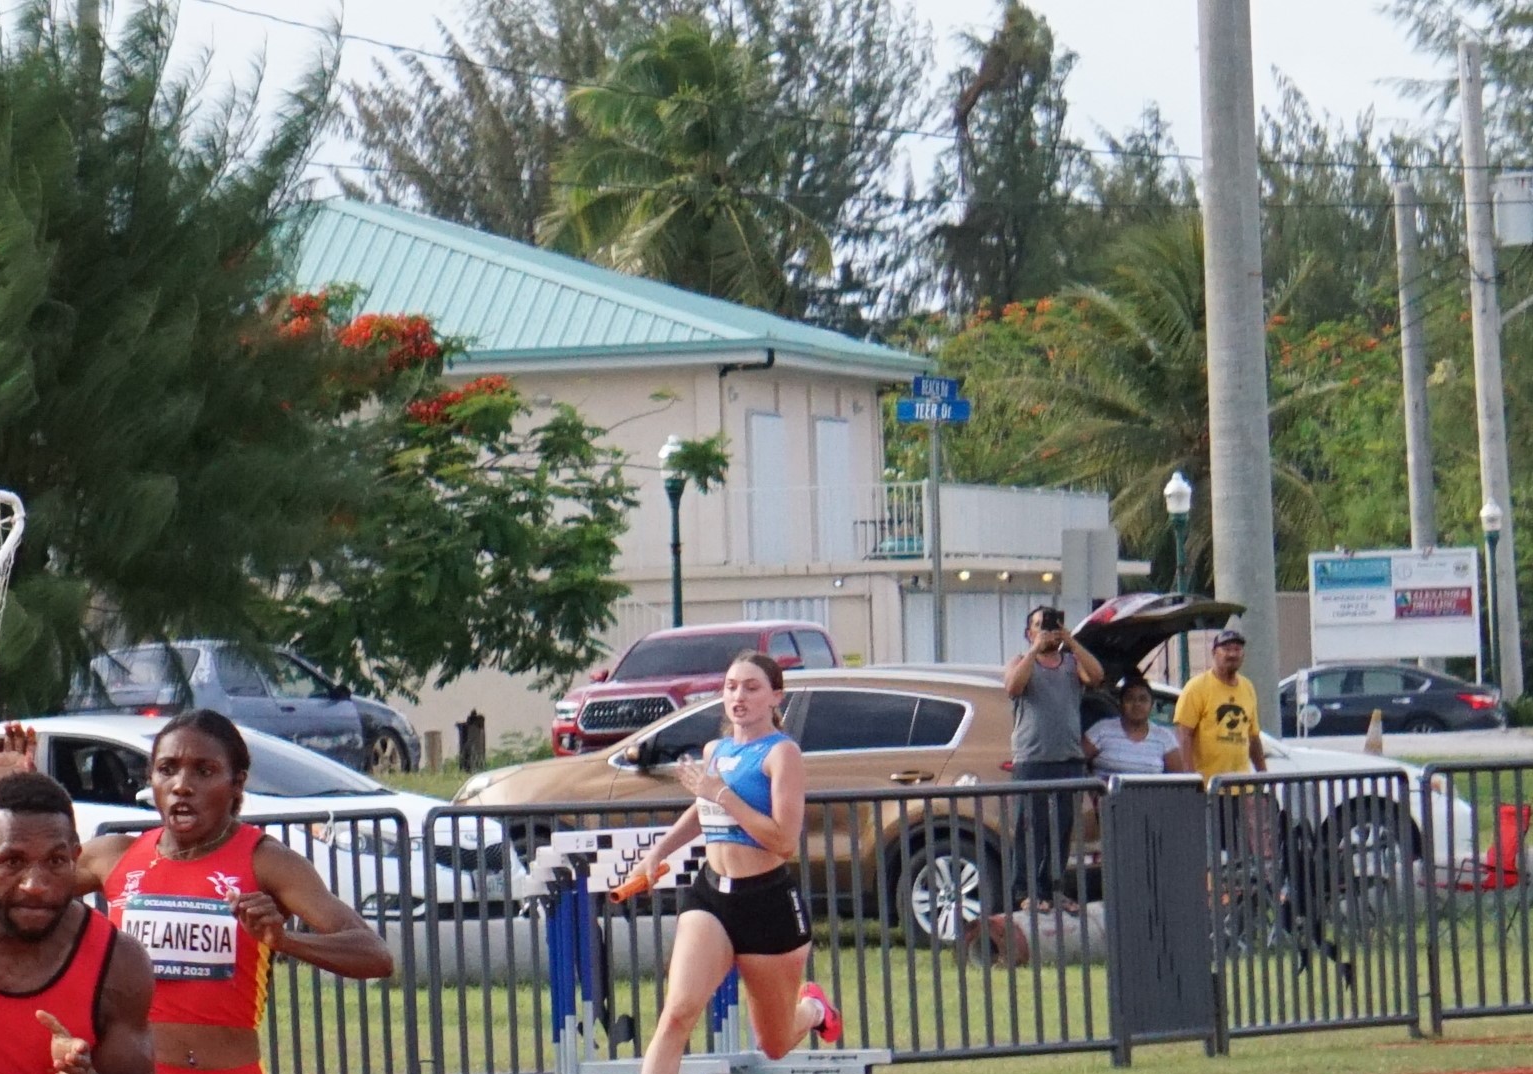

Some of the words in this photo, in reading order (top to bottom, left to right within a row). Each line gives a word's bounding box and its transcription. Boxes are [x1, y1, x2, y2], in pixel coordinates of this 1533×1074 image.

[921, 379, 940, 396] BEACH
[915, 402, 938, 420] TEER
[143, 899, 176, 908] OCEANIA
[176, 901, 218, 911] ATHLETICS
[126, 919, 232, 953] MELANESIA
[153, 964, 182, 975] IPAN
[183, 965, 211, 977] 2023
